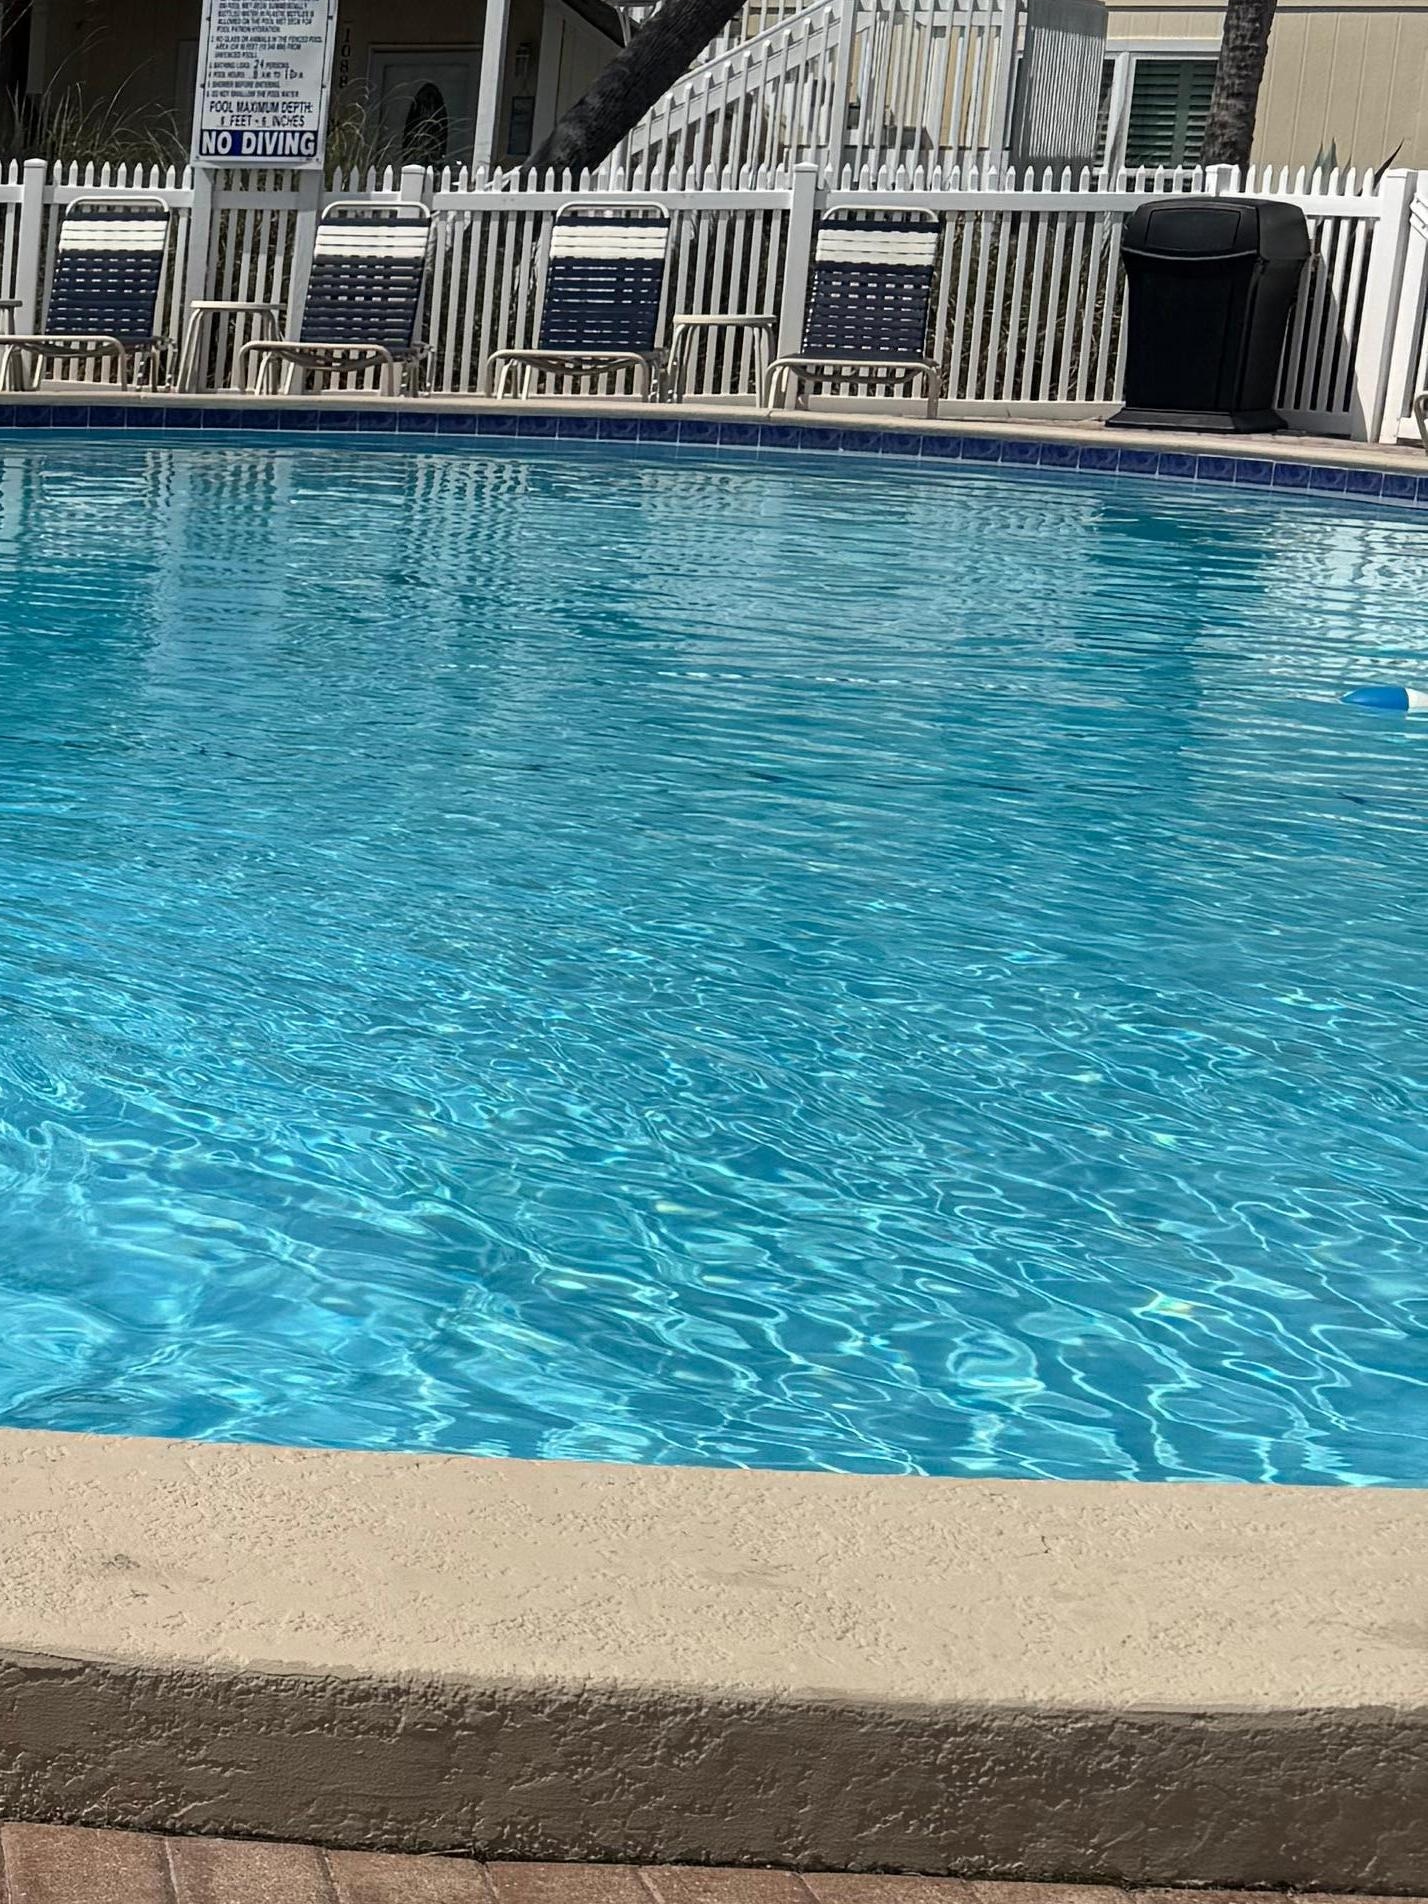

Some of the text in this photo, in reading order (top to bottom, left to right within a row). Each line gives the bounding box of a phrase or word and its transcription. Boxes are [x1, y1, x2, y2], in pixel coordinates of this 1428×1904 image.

[209, 100, 234, 113] POOL
[236, 101, 279, 114] MAXIMUM
[230, 114, 252, 127] FEET
[272, 115, 305, 127] INCHES
[201, 130, 316, 156] NO DIVING
